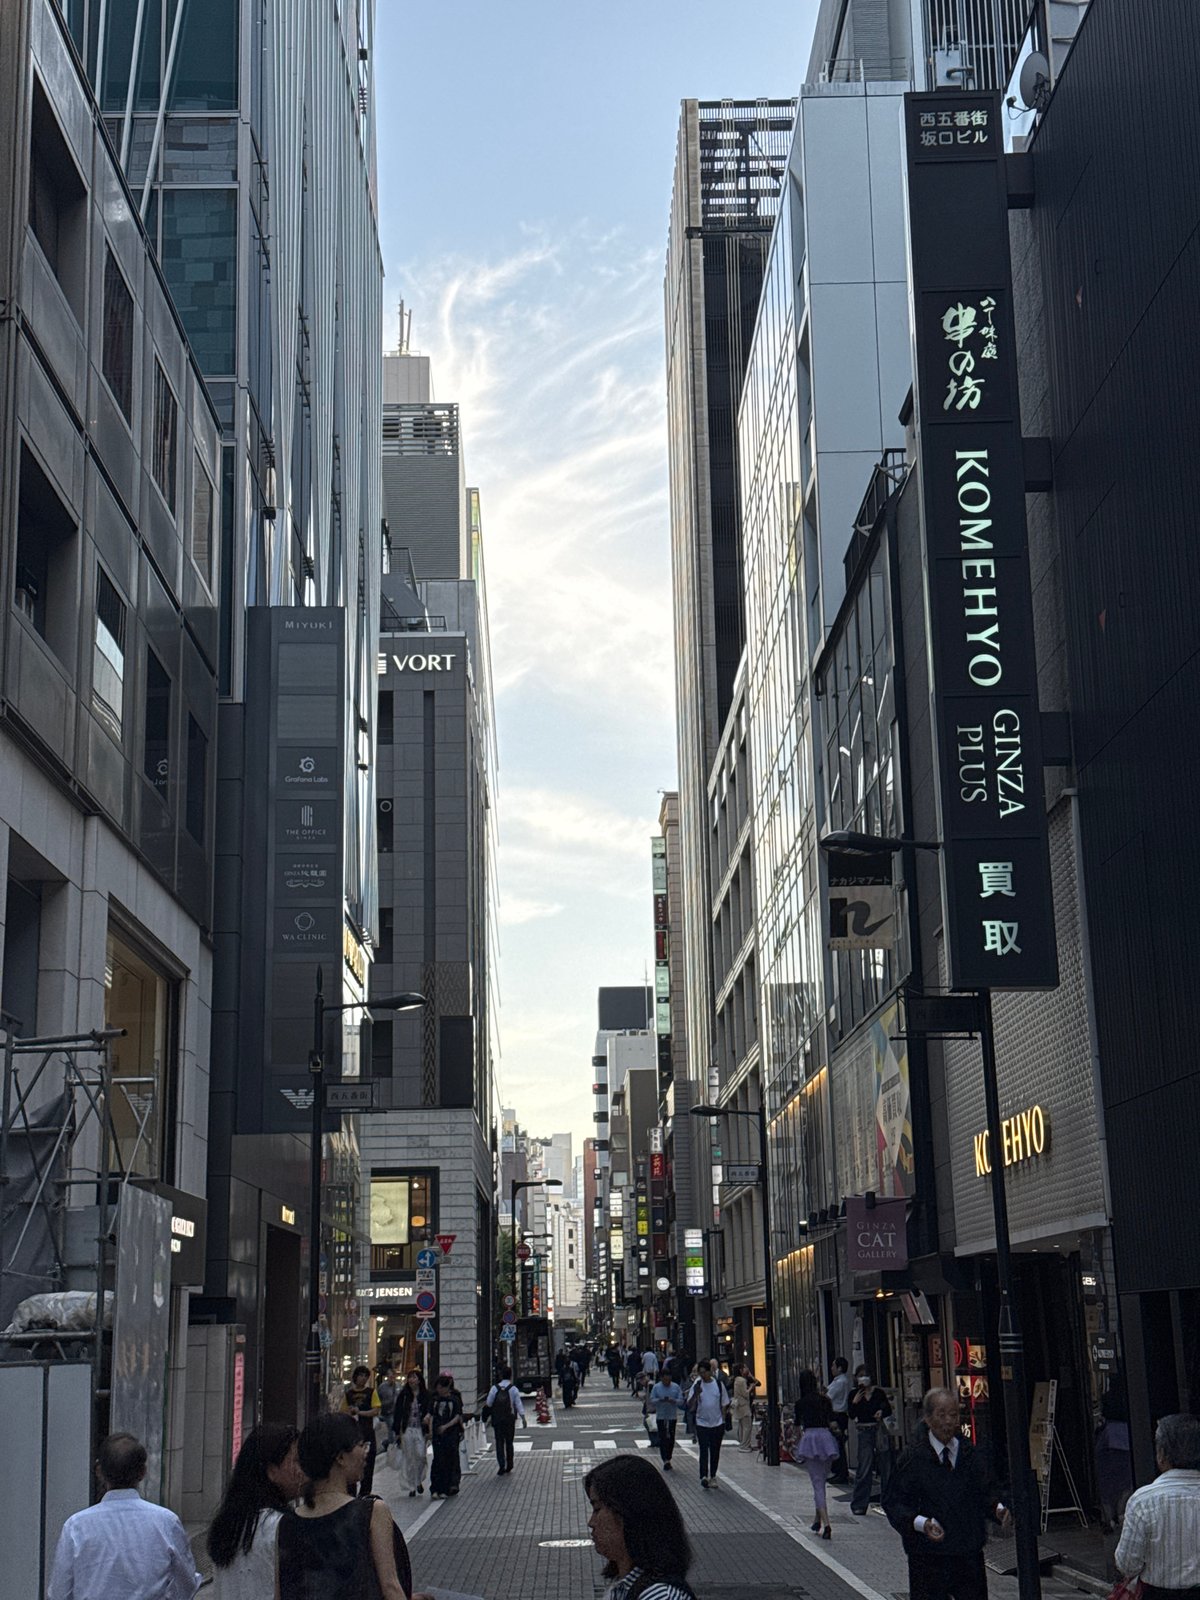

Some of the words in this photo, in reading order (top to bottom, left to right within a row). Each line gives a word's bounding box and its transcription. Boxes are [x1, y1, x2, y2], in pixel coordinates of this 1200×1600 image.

[919, 109, 988, 127] 西五番街
[919, 129, 988, 147] 坂口ビル
[940, 302, 986, 411] 串の坊
[955, 449, 1002, 687] KOMEHYO
[393, 654, 456, 671] VORT
[956, 724, 987, 803] PLUS
[993, 709, 1025, 819] GINZA
[285, 775, 312, 783] Grafana
[313, 775, 328, 783] Labs
[830, 876, 890, 886] ナカジマアート
[978, 861, 1022, 956] 買取
[974, 1104, 1045, 1177] KOEHYO
[857, 1221, 896, 1230] GINZA
[857, 1232, 896, 1248] CAT
[857, 1249, 896, 1258] GALLERY
[375, 1287, 413, 1299] JENSEN
